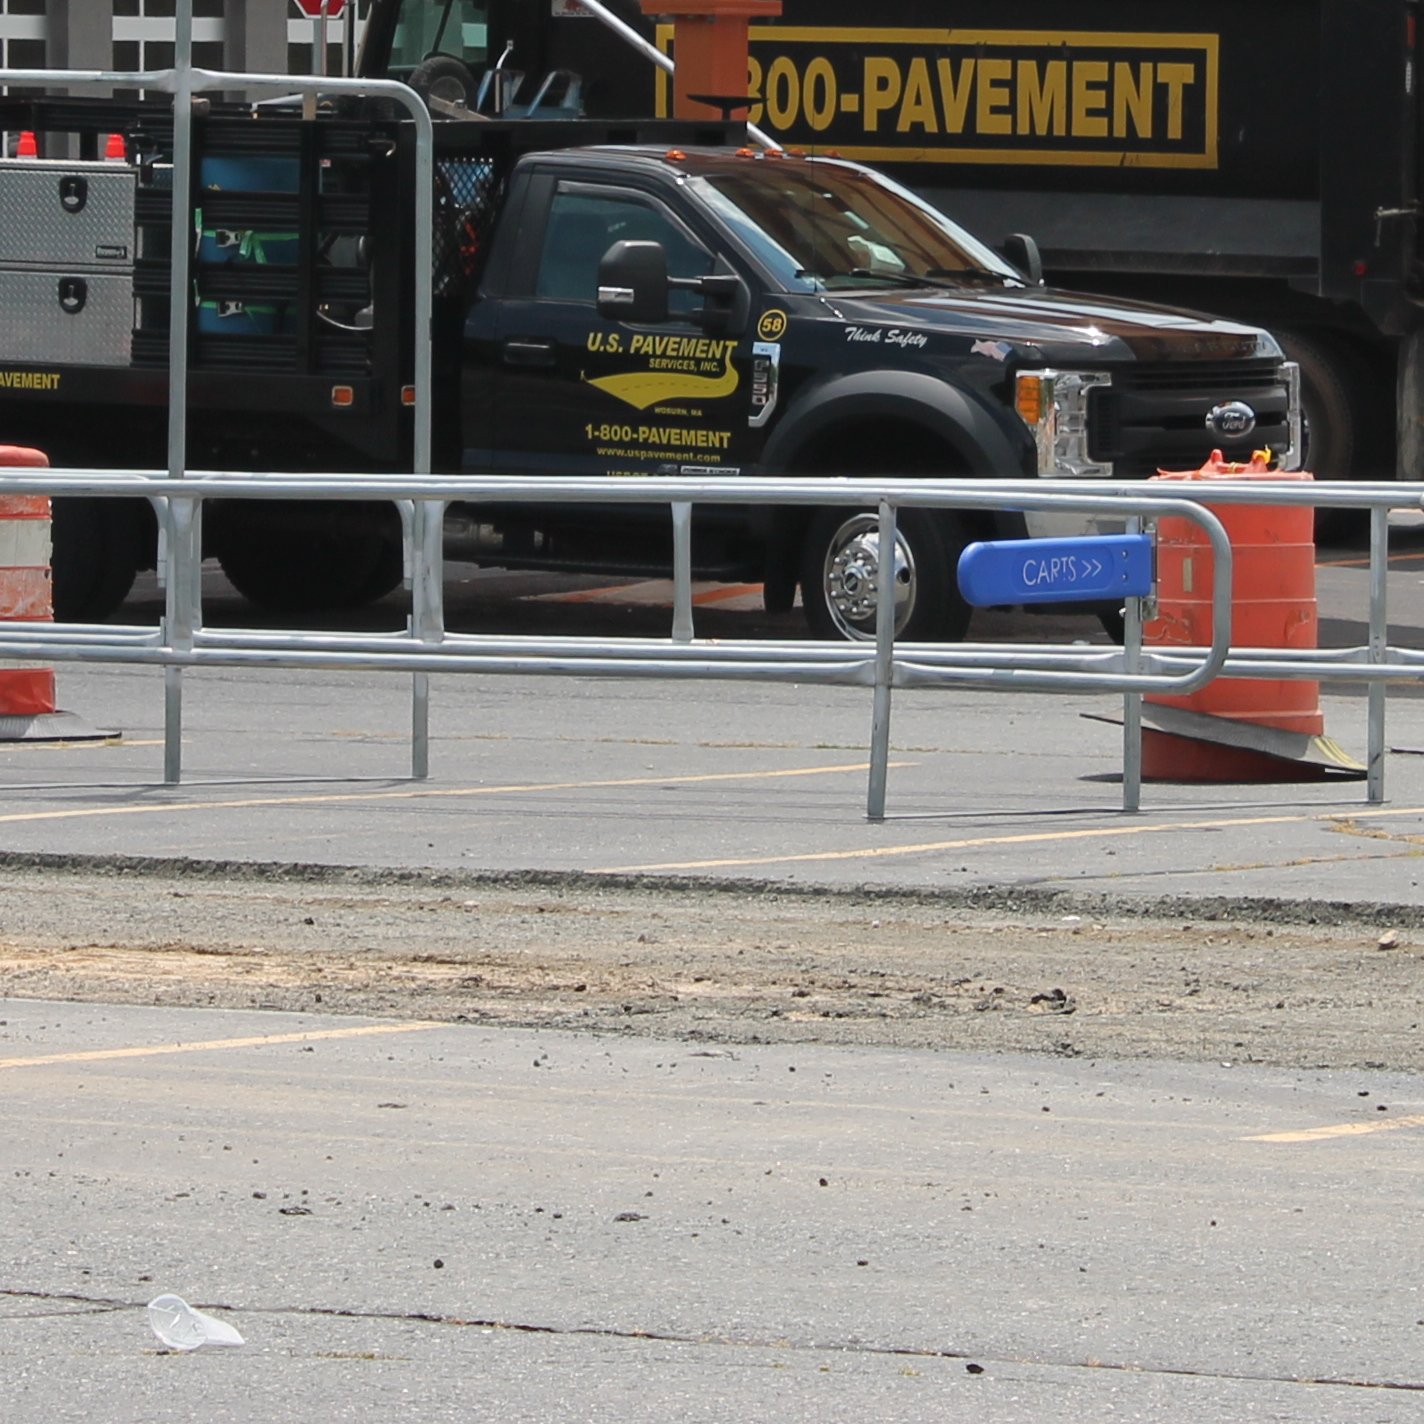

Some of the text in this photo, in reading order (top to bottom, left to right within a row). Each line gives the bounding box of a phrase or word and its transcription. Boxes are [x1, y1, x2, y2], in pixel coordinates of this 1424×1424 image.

[762, 318, 782, 332] 58
[587, 332, 738, 360] U.S. PAVEMENT
[844, 326, 928, 348] Think Safety
[649, 358, 720, 372] SERVICES, INC.
[691, 409, 702, 417] MA
[1222, 411, 1246, 430] Ford
[585, 423, 732, 449] 1-800-PAVEMENT
[596, 446, 721, 462] www.uspavement.com
[1022, 555, 1076, 586] CARTS
